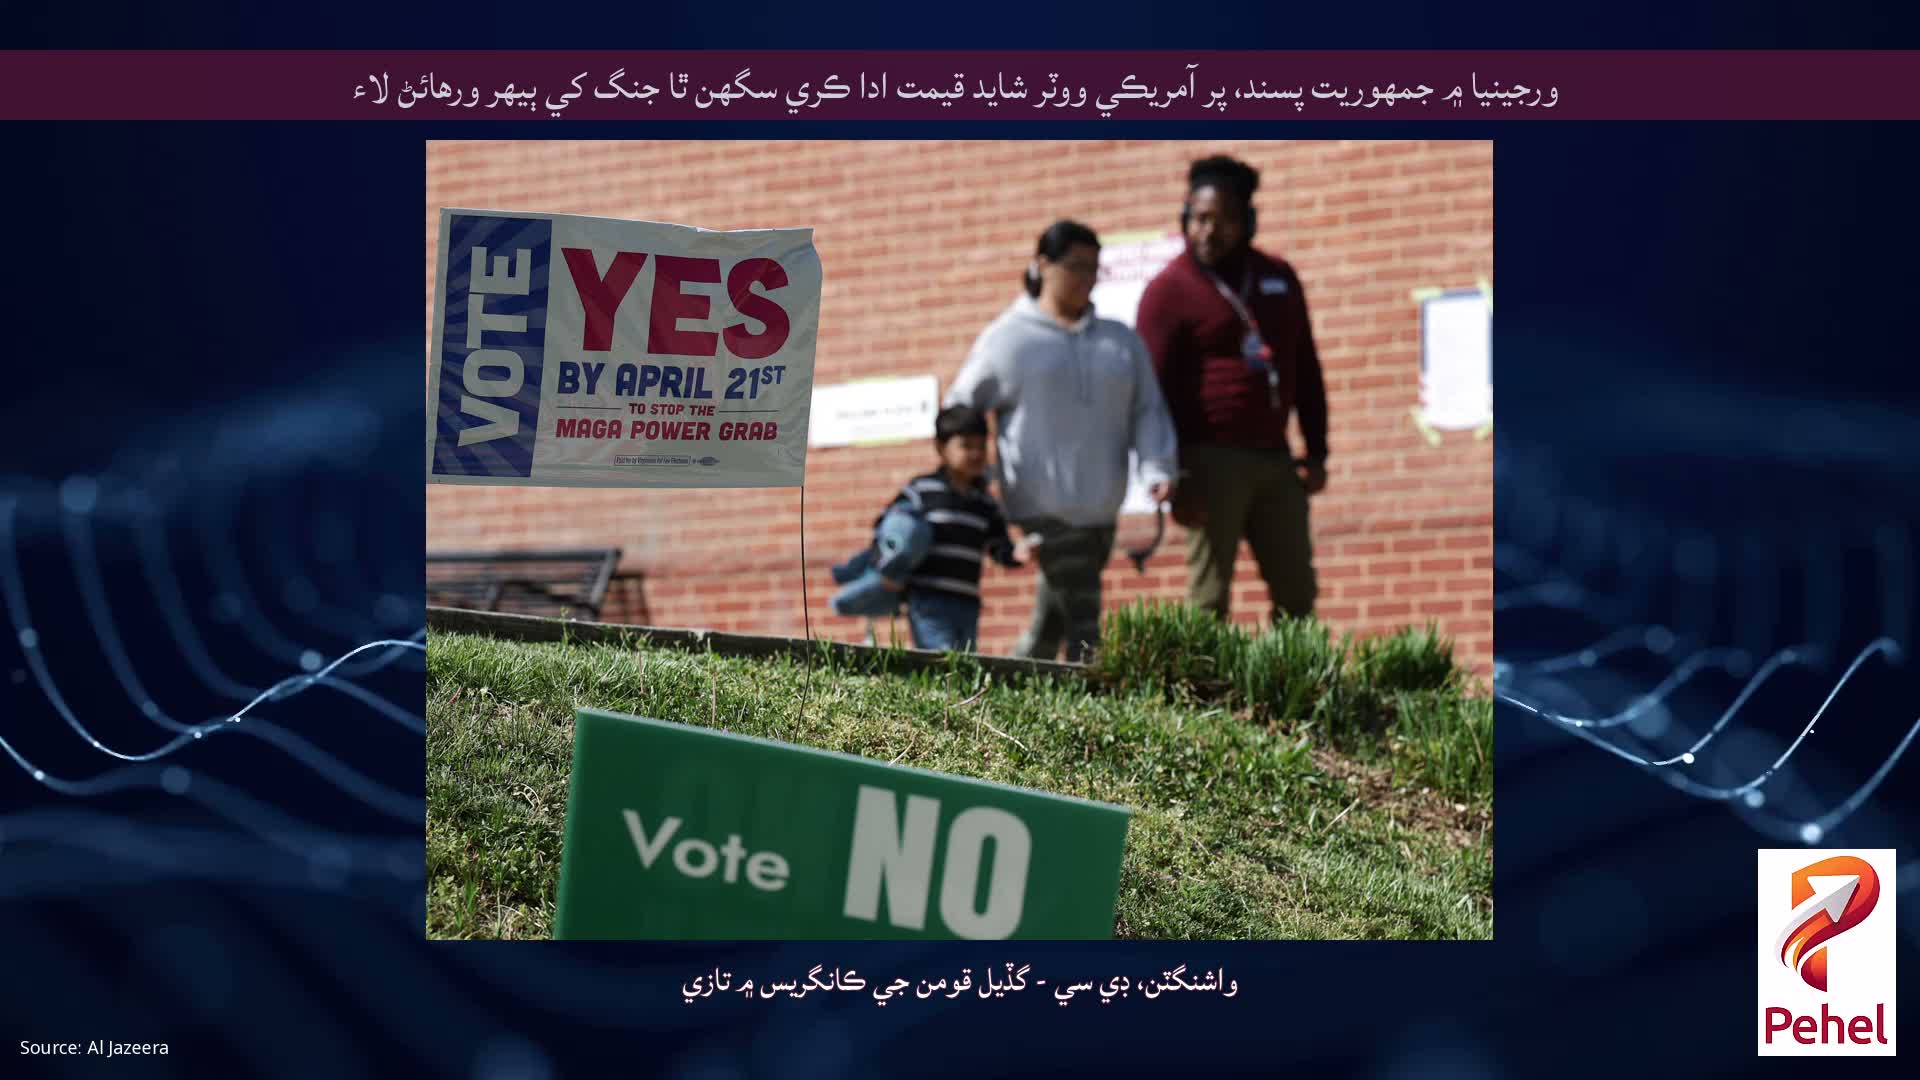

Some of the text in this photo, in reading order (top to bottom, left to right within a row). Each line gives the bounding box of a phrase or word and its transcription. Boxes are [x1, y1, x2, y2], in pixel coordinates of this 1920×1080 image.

[561, 247, 791, 359] YES
[458, 246, 532, 446] VOTE
[557, 361, 786, 400] BY APRIL 21ST
[556, 419, 778, 441] MAGA POWER GRAB
[629, 403, 716, 417] TO STOP THE
[621, 784, 1033, 940] Vote NO
